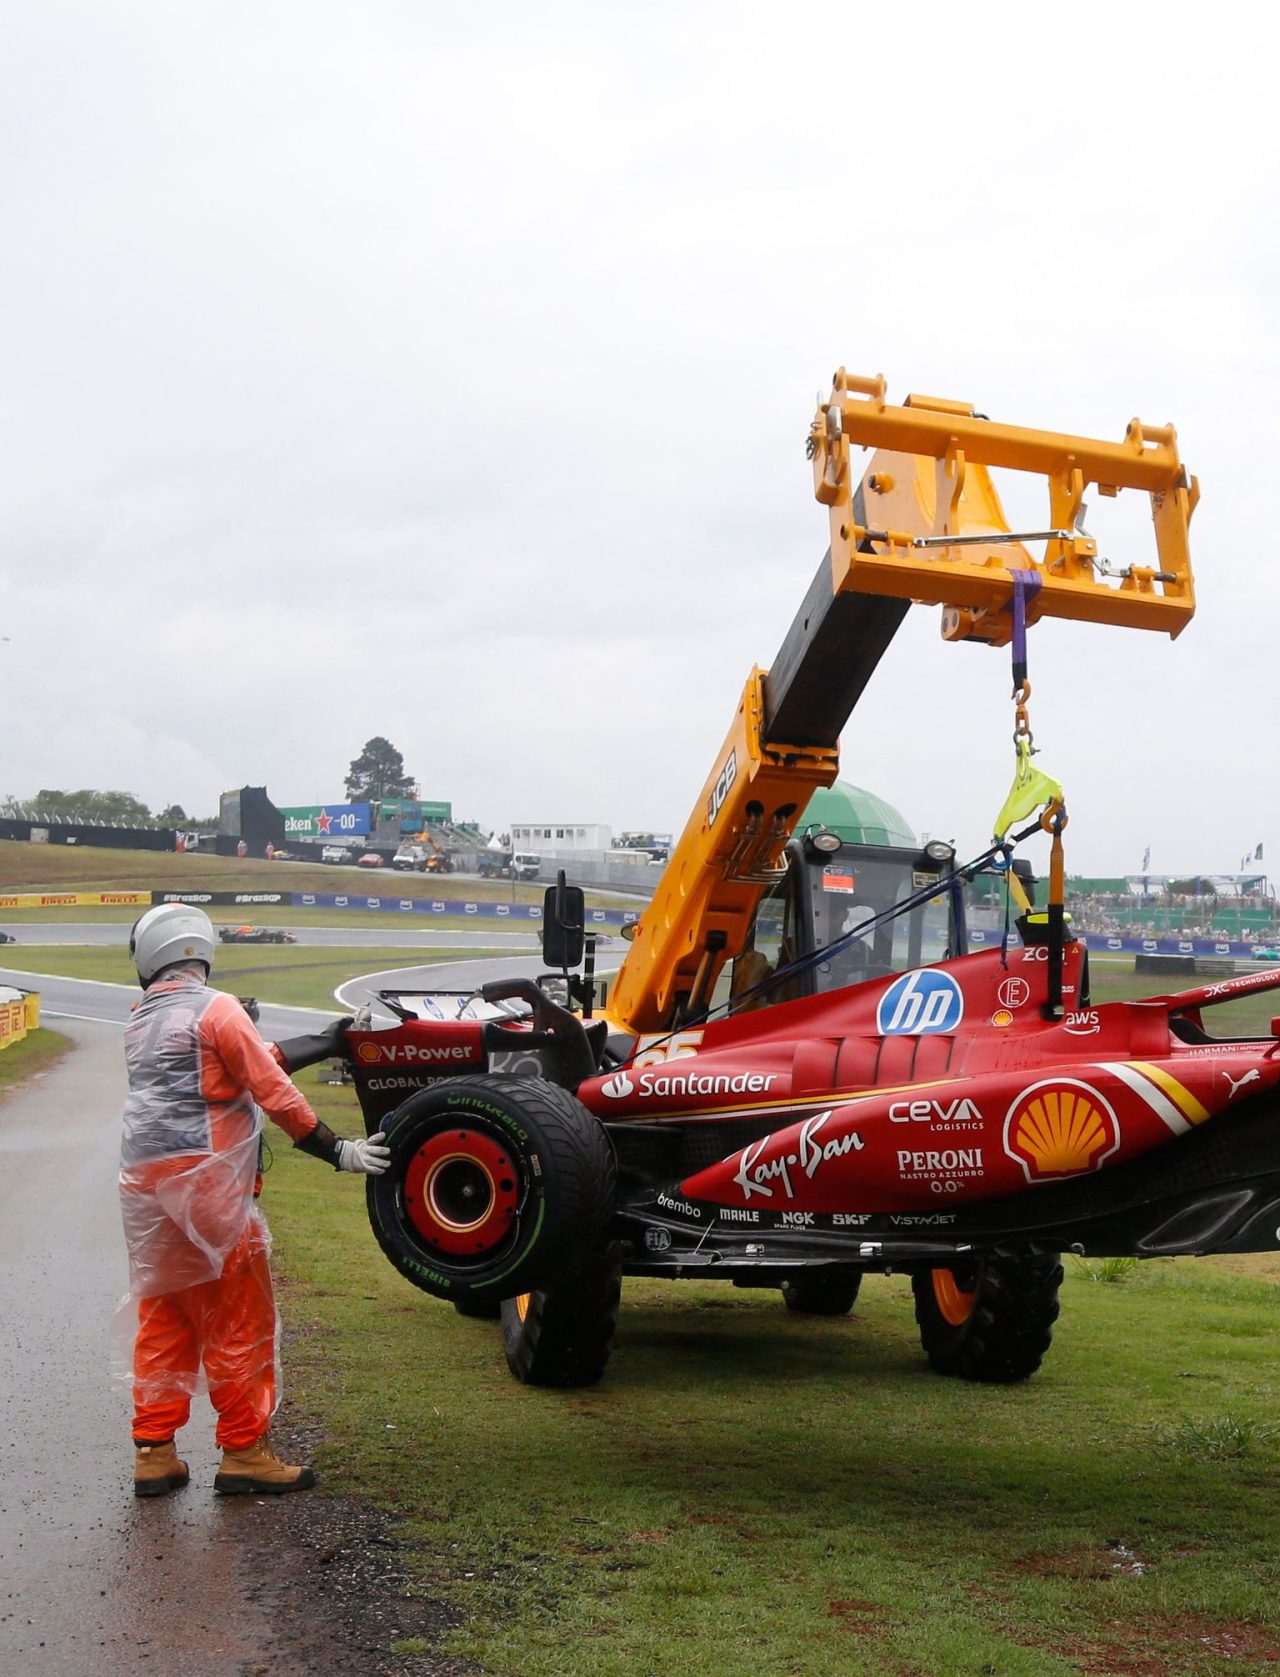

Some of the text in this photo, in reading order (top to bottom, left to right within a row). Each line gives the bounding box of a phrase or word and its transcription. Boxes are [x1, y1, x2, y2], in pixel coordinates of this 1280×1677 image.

[709, 750, 737, 829] JCB
[971, 931, 985, 940] aws
[1107, 939, 1122, 948] aws
[1142, 940, 1157, 949] aws
[1178, 942, 1193, 950] aws
[1215, 943, 1230, 952] aws
[1230, 974, 1279, 987] TECHNOLOGY
[886, 971, 954, 1033] hp
[1065, 1011, 1099, 1027] aws
[381, 1045, 473, 1061] V-Power
[1187, 1046, 1236, 1056] HARMAN
[368, 1077, 425, 1090] GLOBAL
[639, 1071, 777, 1098] Santander
[930, 1122, 984, 1131] LOGISTICS
[896, 1148, 984, 1171] PERONI
[900, 1170, 984, 1180] NASTRO AZZURRO
[657, 1193, 701, 1218] brembo
[719, 1208, 760, 1222] MAHLE
[782, 1212, 815, 1225] NGK
[832, 1214, 872, 1225] SKF
